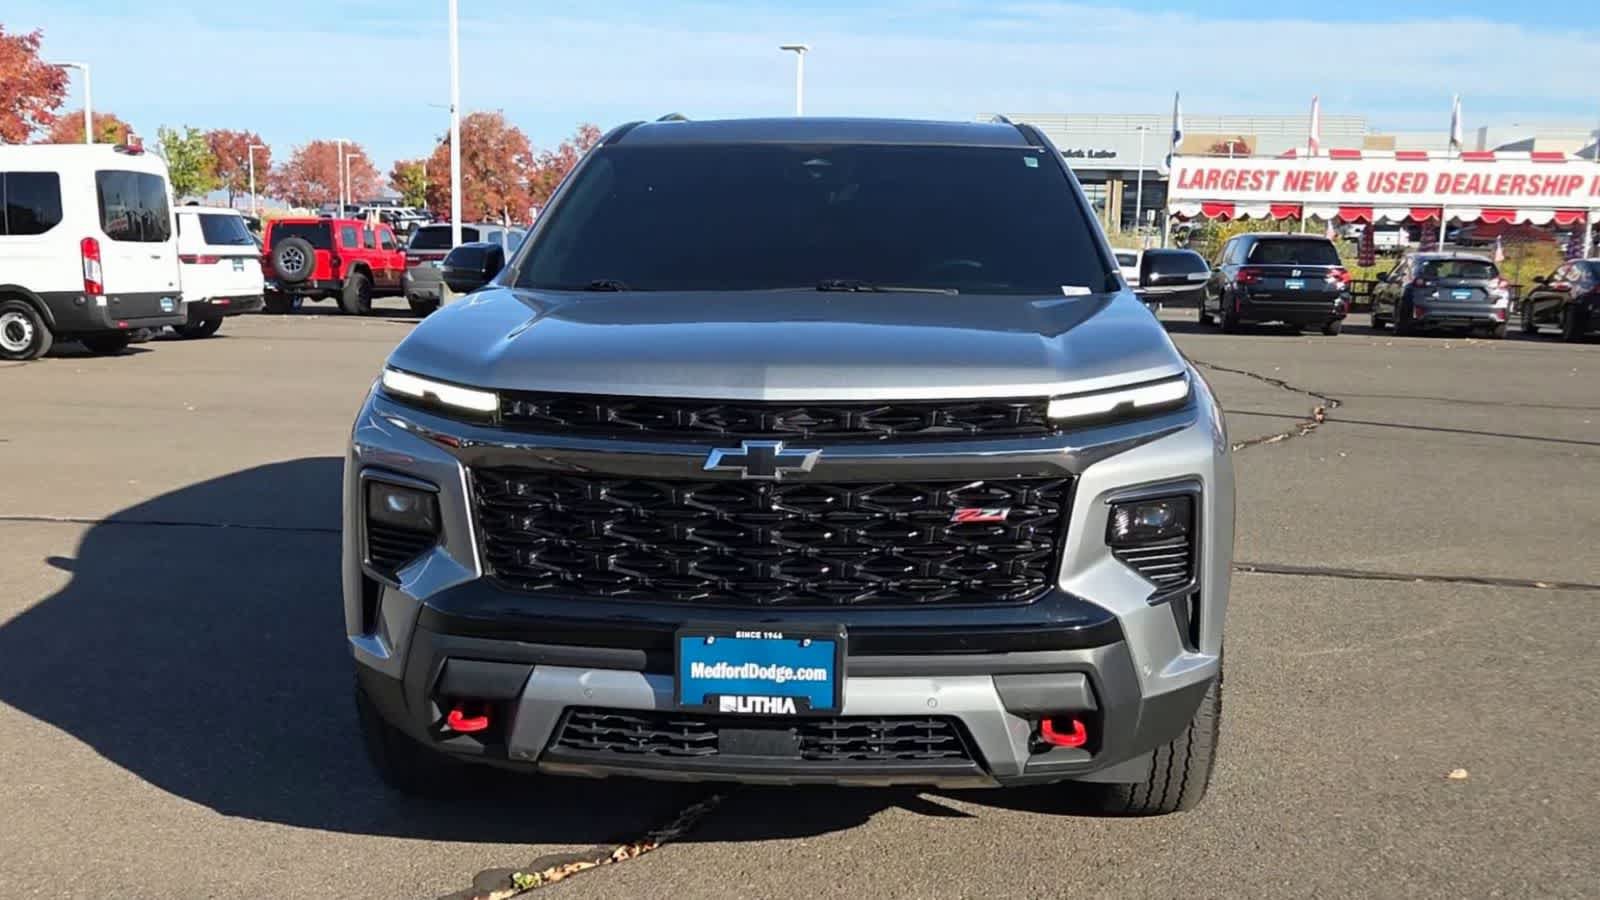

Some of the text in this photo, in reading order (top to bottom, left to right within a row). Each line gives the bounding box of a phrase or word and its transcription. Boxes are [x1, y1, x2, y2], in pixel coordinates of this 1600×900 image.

[1176, 167, 1279, 191] LARGEST
[1283, 170, 1338, 193] NEW
[1341, 171, 1360, 193] &
[1366, 171, 1428, 195] USED
[1434, 172, 1585, 197] DEALERSHIP
[735, 631, 761, 639] SINCE
[691, 661, 827, 683] MedfordDodge.com
[737, 695, 796, 714] LITHIA
